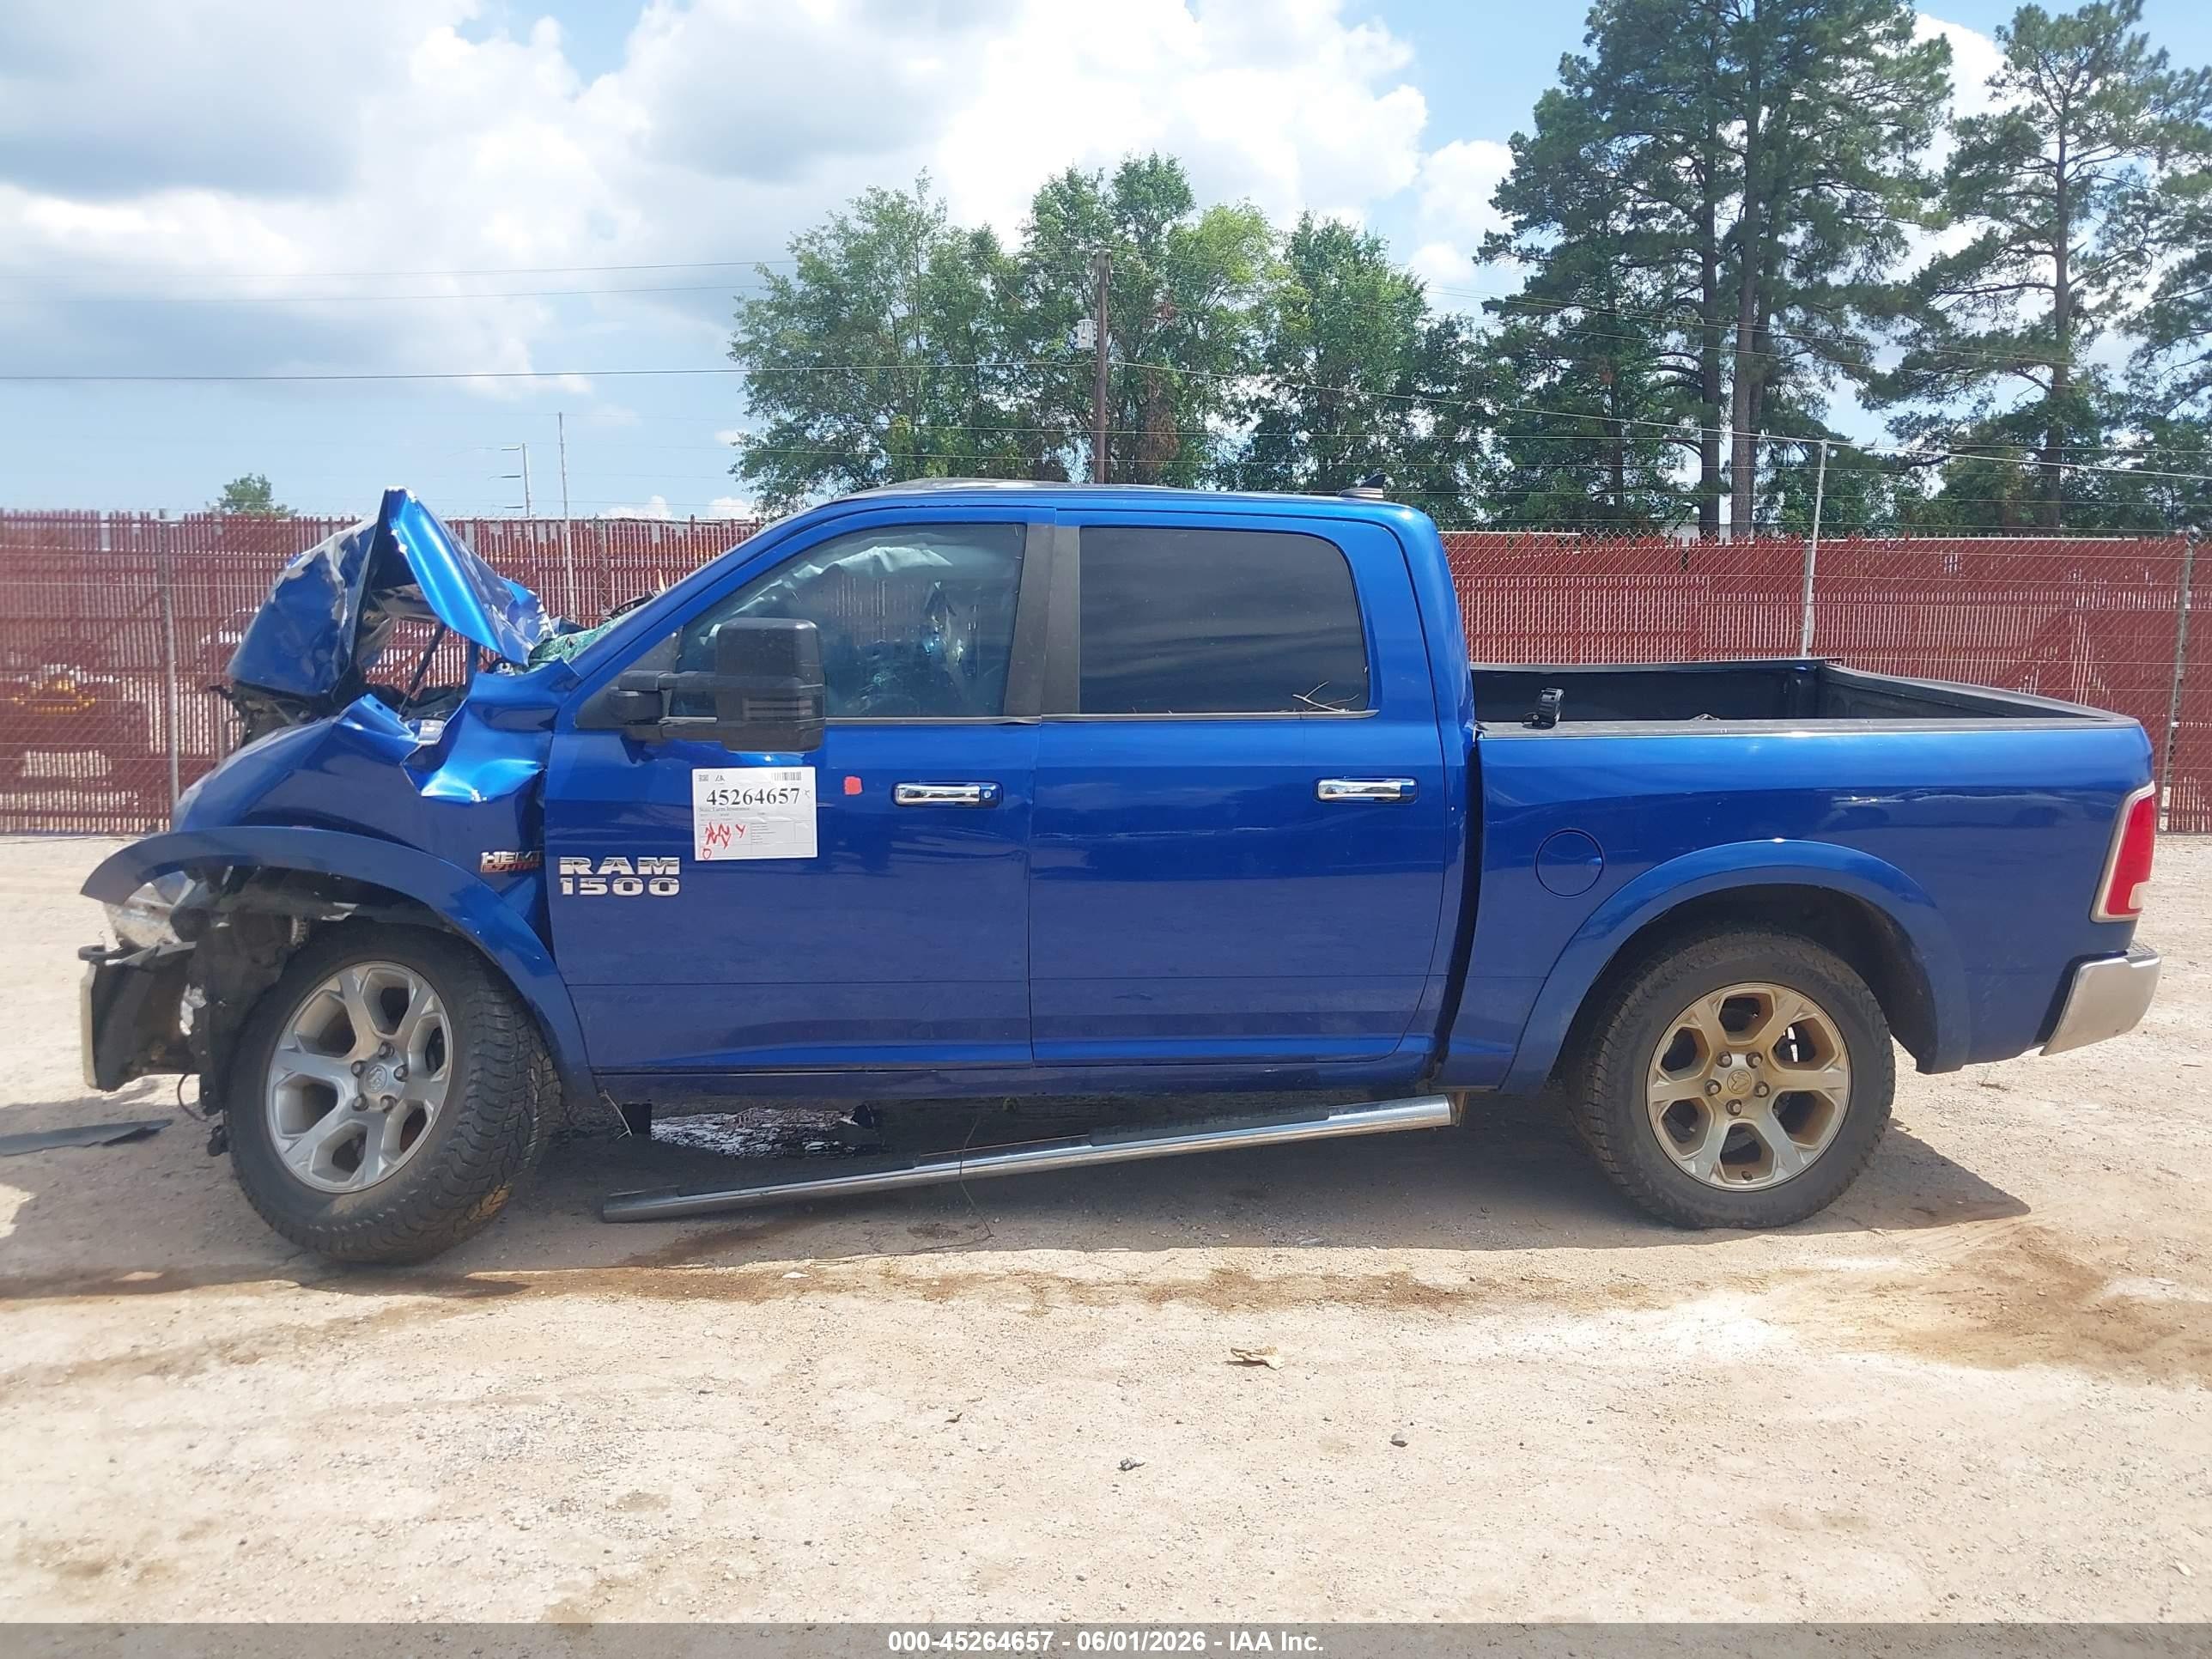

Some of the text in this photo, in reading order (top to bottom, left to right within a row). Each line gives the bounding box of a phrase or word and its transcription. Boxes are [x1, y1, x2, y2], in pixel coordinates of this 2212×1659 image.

[707, 788, 799, 806] 45264657
[559, 856, 681, 875] RAM
[559, 878, 679, 896] 1500
